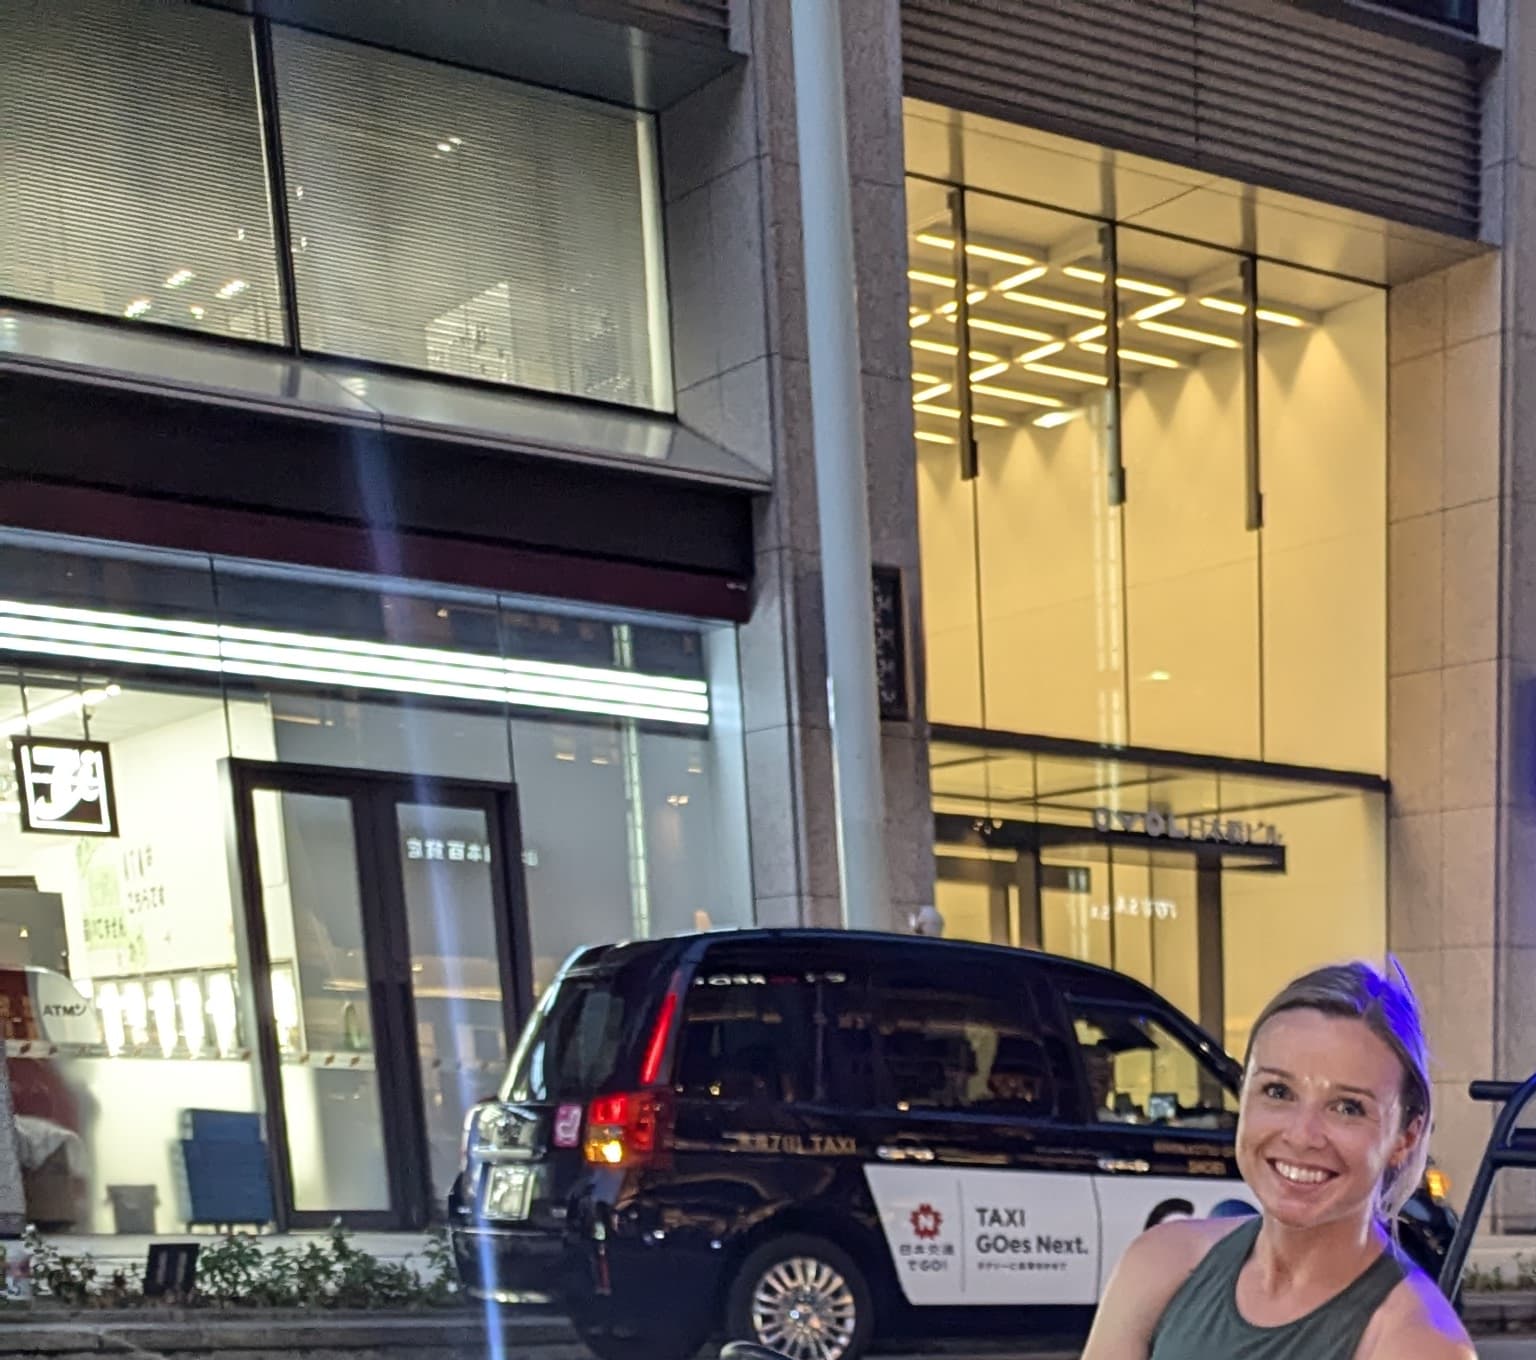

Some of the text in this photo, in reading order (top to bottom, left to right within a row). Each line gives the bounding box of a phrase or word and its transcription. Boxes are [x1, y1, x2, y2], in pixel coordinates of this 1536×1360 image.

[975, 1207, 1027, 1228] TAXI
[975, 1234, 1090, 1255] GOes Next.
